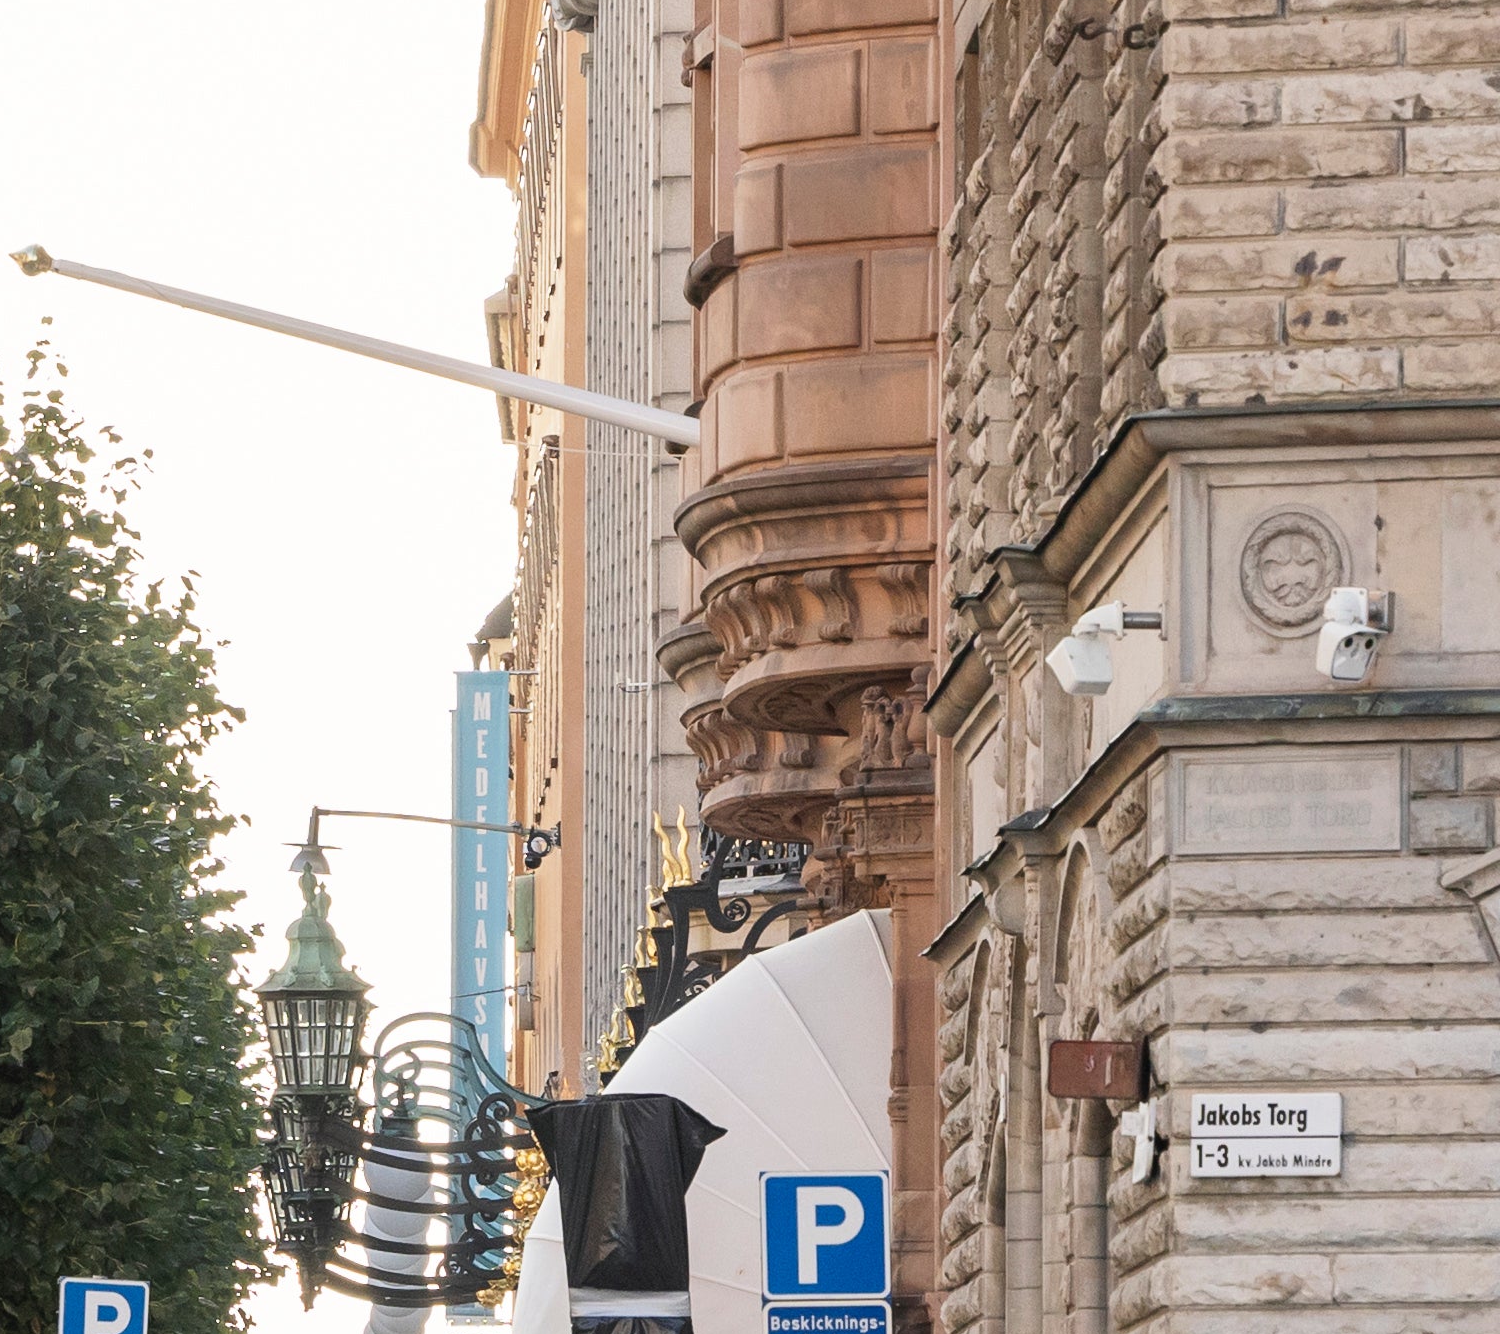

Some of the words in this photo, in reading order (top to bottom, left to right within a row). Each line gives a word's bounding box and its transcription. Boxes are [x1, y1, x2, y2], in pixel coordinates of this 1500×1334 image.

[1198, 1103, 1261, 1126] Jakobs
[1267, 1103, 1307, 1133] Torg
[1196, 1144, 1229, 1168] 1-3
[1256, 1155, 1288, 1168] Jakob
[1293, 1155, 1332, 1168] Mindre
[796, 1185, 865, 1285] P
[770, 1315, 886, 1333] Beskicknings-
